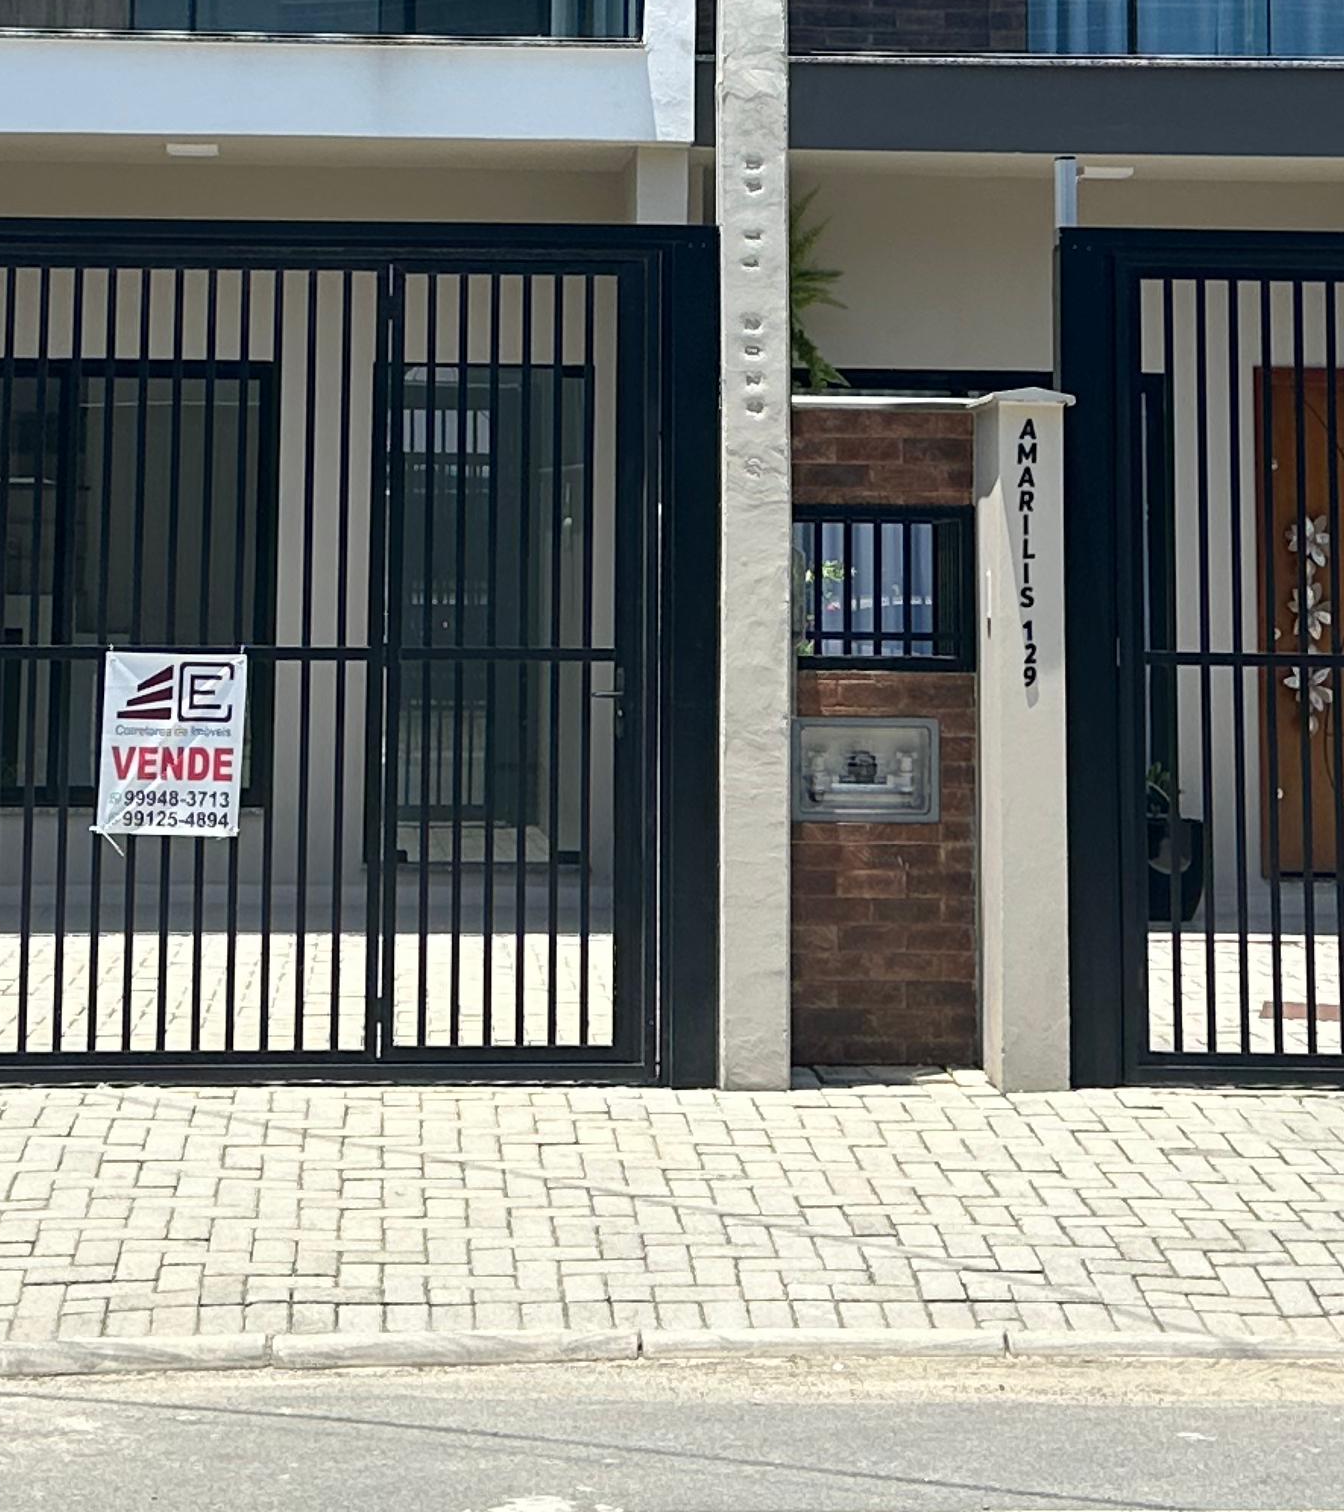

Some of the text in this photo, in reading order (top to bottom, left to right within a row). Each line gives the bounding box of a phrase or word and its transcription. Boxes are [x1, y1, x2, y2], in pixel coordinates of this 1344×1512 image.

[1017, 418, 1037, 687] AMARILIS 129
[112, 747, 234, 782] VENDE
[123, 790, 230, 808] 99948-3713
[122, 810, 230, 828] 99125-4894
